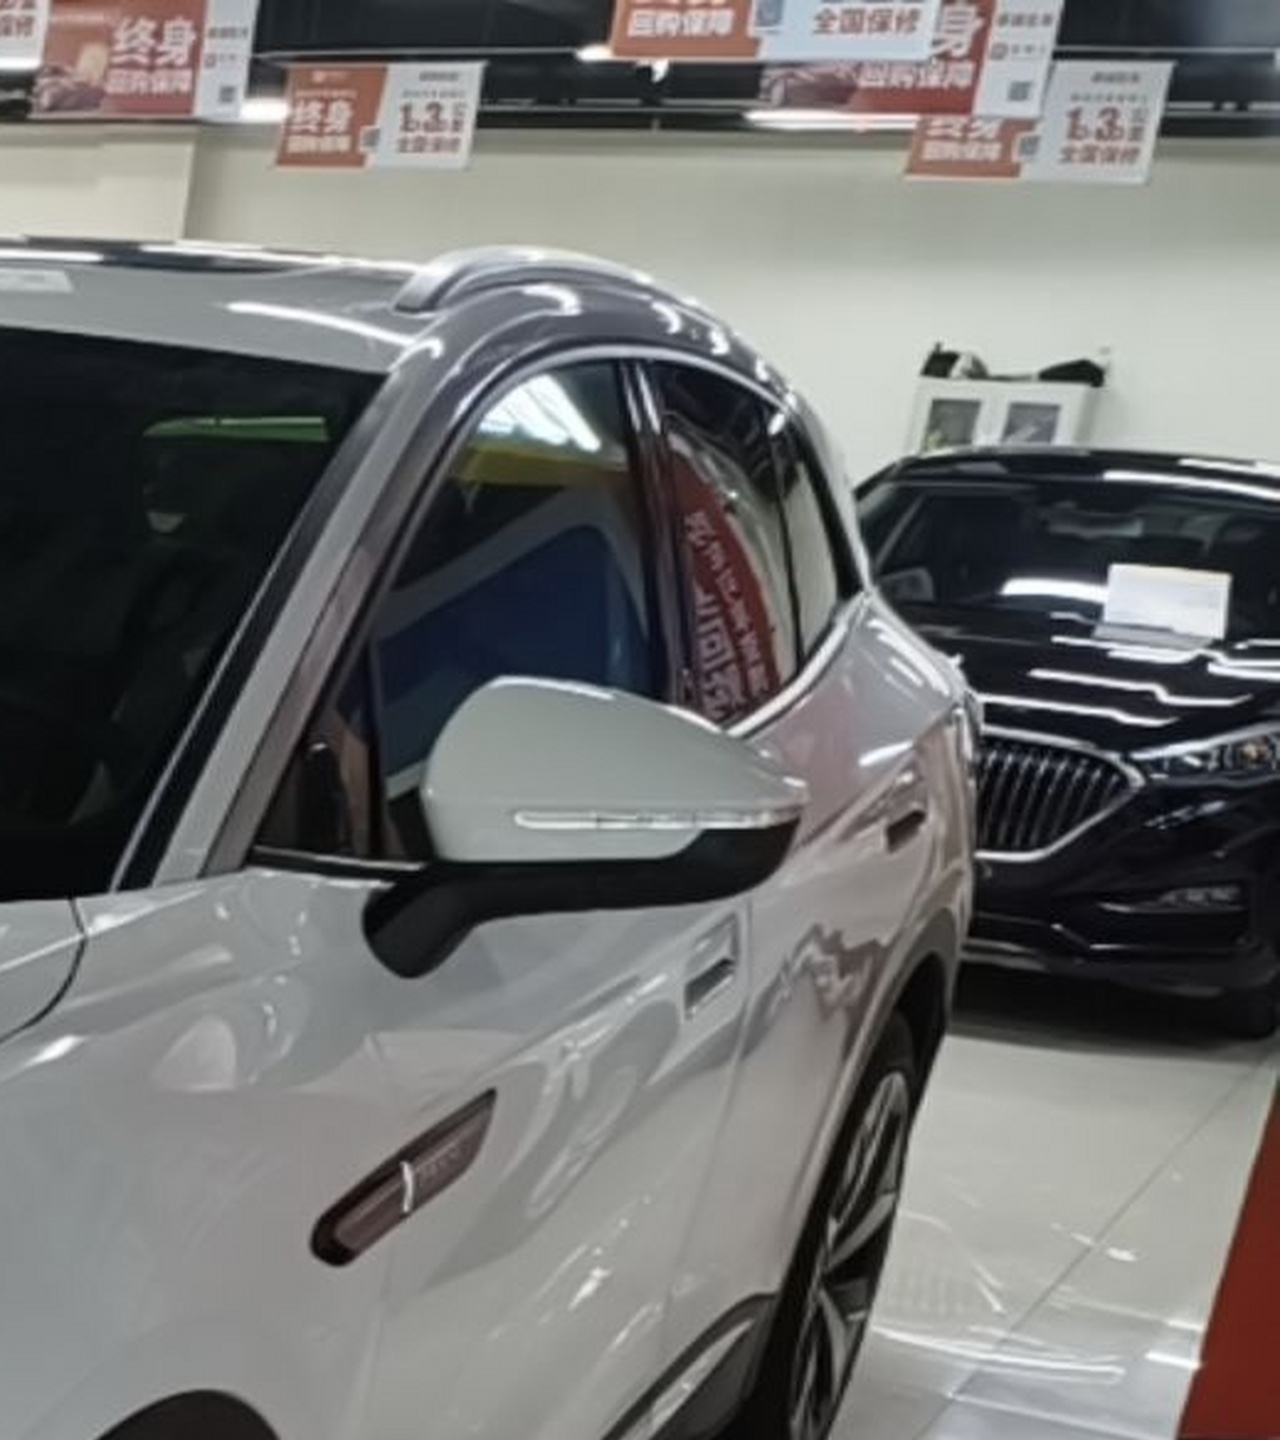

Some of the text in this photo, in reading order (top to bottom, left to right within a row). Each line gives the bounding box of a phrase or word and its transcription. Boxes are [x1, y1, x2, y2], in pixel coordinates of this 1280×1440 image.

[627, 9, 734, 37] 回购保障
[813, 8, 923, 35] 全国保修
[110, 16, 197, 66] 终身
[290, 101, 354, 135] 终身
